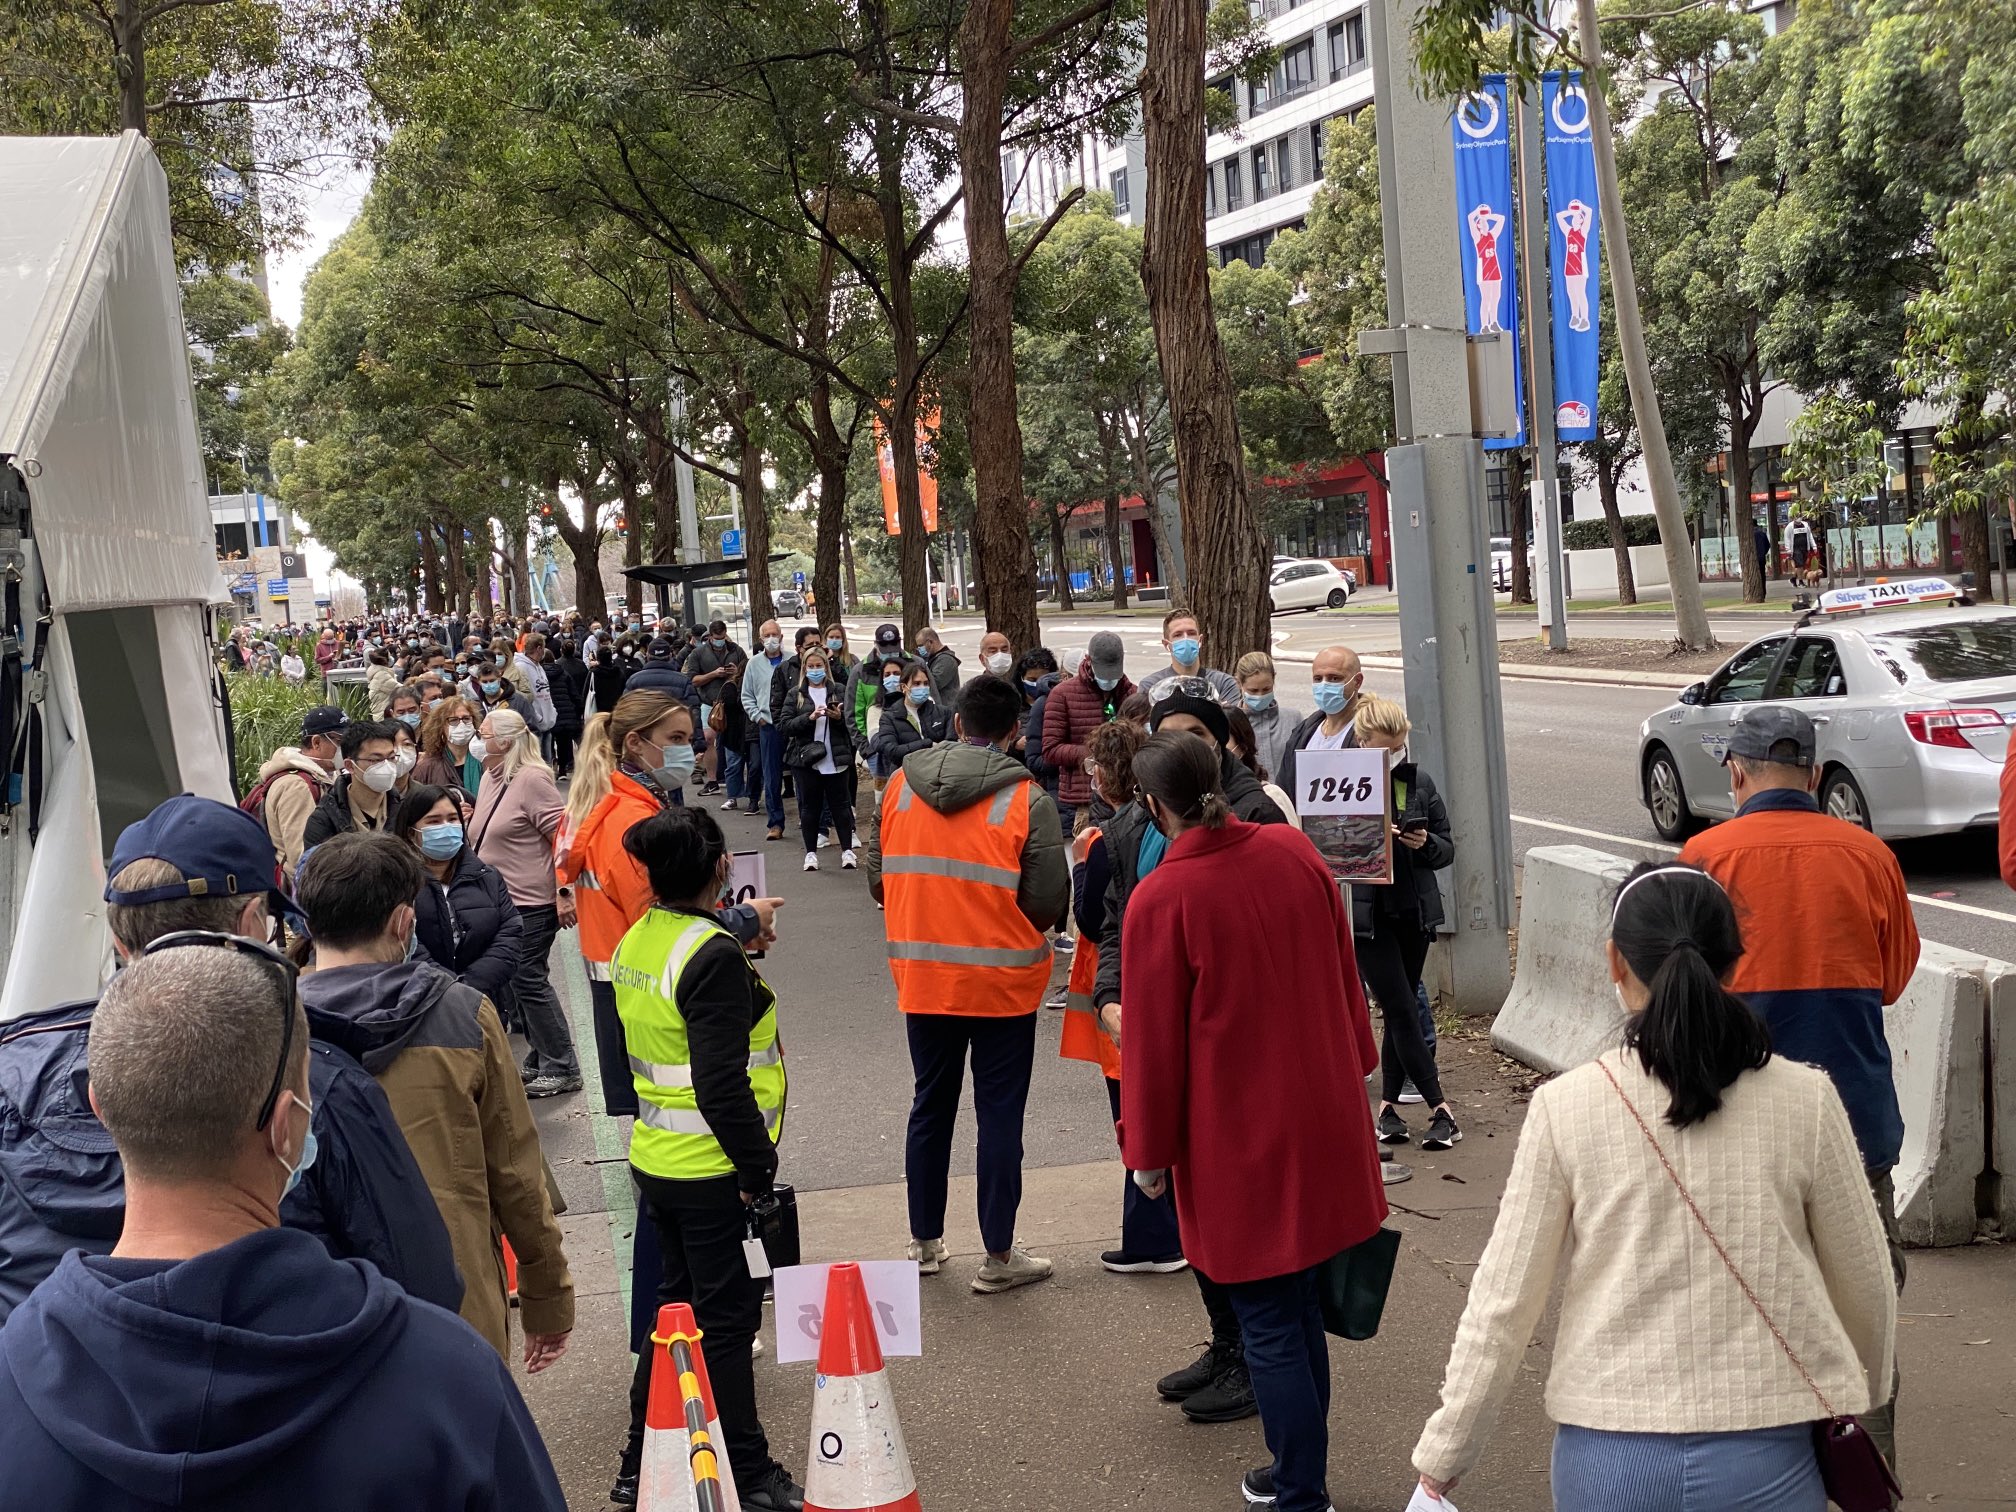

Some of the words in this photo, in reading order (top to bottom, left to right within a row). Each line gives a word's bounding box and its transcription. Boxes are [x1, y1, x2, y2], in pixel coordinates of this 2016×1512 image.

[1456, 138, 1506, 149] SydneyOlympicPark
[1836, 592, 1867, 604] Silver
[1869, 585, 1906, 598] TAXI
[1906, 581, 1946, 595] Service
[1308, 776, 1373, 802] 1245
[615, 964, 659, 995] ECURITY
